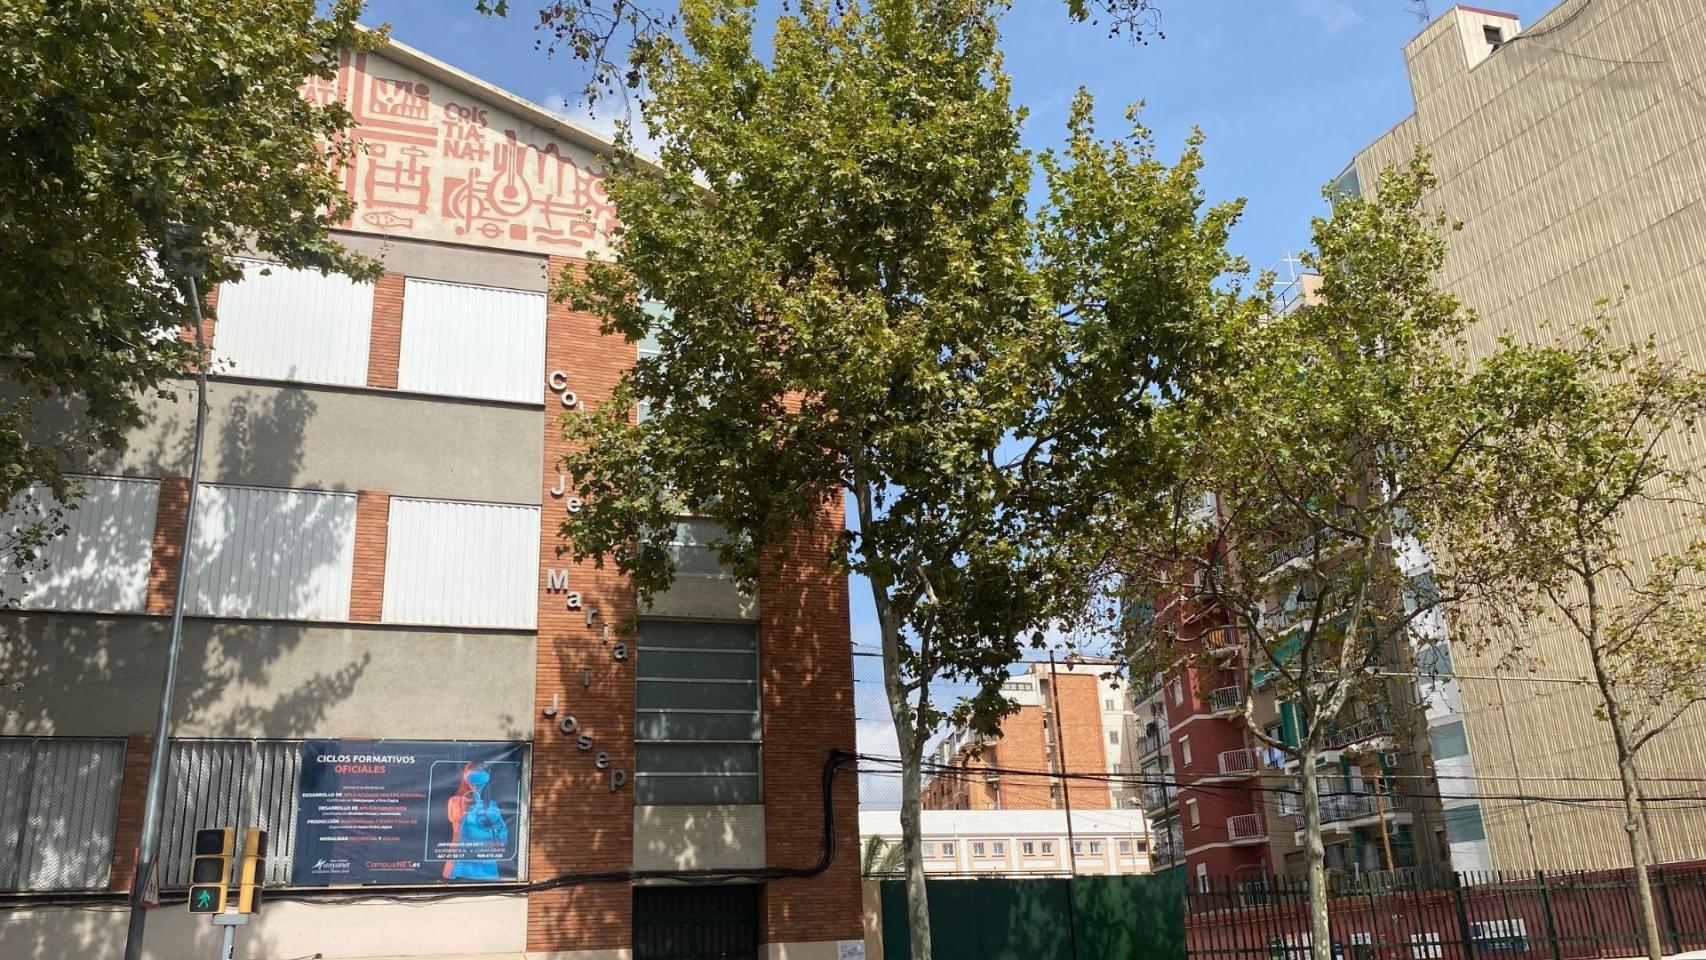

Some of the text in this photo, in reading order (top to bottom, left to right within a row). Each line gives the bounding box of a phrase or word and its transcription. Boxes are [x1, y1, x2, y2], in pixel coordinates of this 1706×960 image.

[543, 692, 627, 792] Josep
[317, 755, 416, 764] CICLOS FORMATIVOS
[335, 765, 386, 774] OFICIALES
